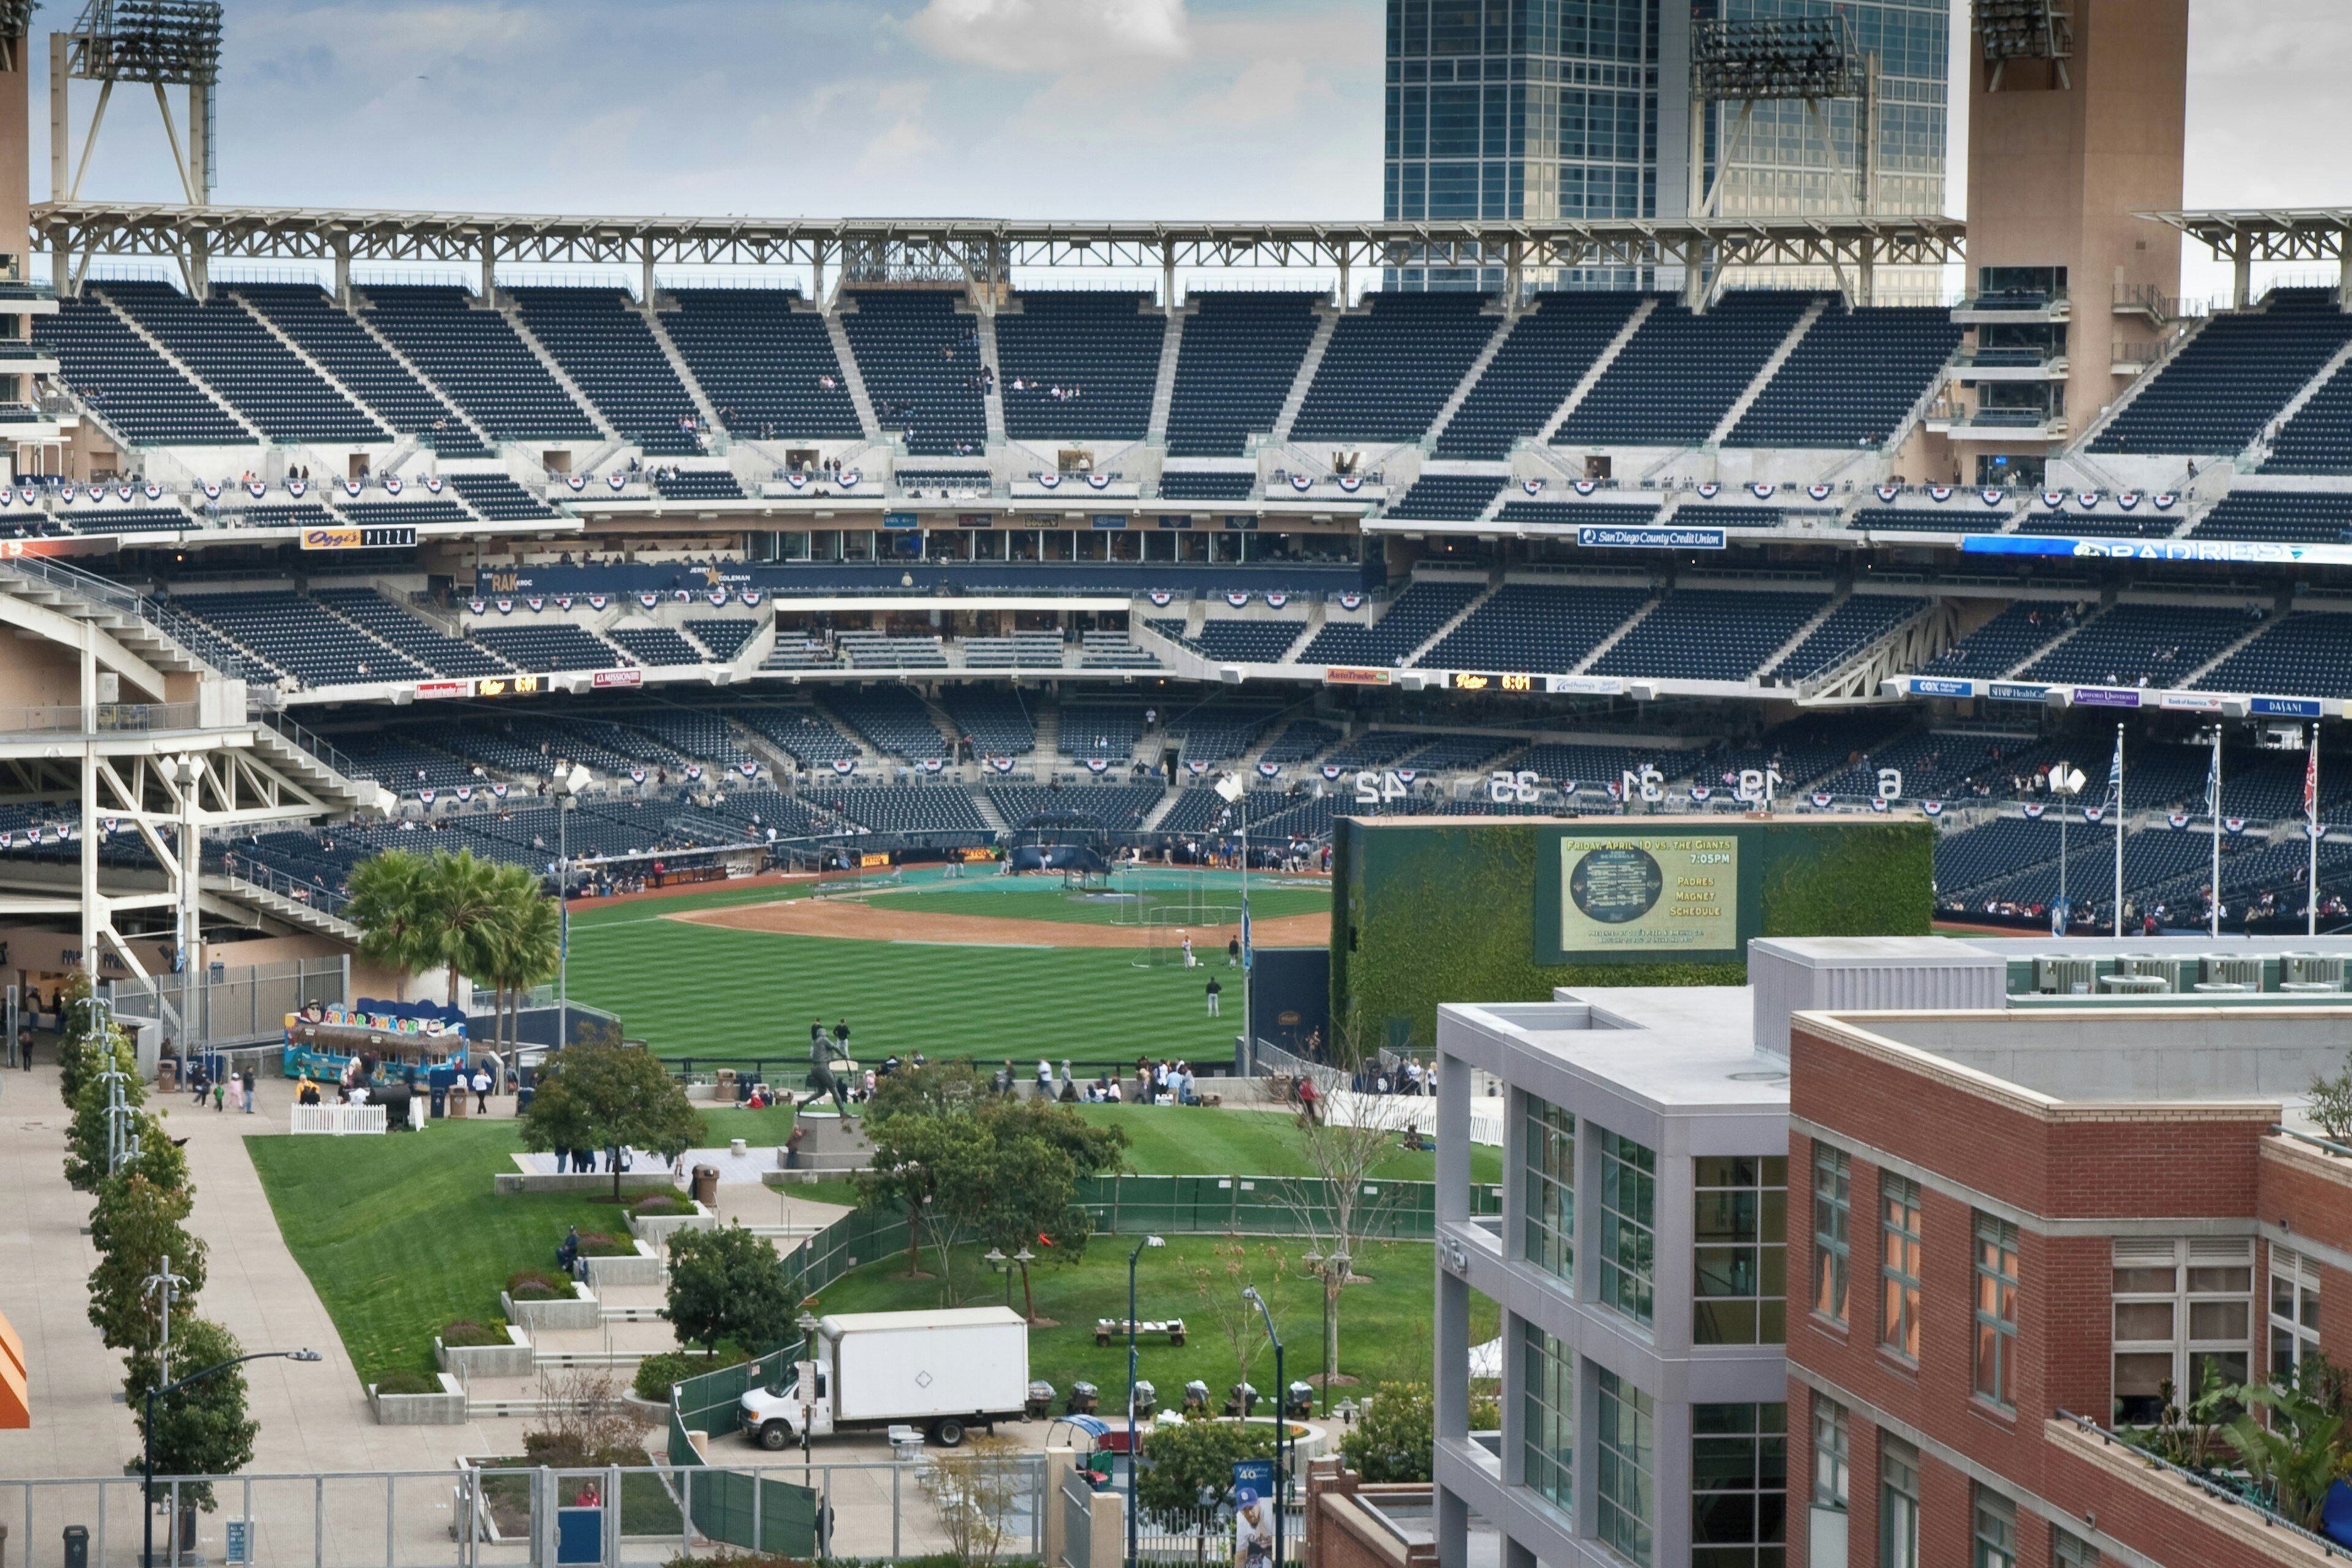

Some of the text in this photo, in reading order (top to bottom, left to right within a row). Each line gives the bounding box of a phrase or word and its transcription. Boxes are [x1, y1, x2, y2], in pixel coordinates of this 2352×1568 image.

[308, 530, 412, 546] Oggi's PIZZA
[1599, 531, 1719, 545] San Diego County Credit Union
[492, 573, 518, 592] RAK
[605, 673, 630, 682] MISSION
[1329, 670, 1376, 680] AutoTrader
[1502, 674, 1531, 690] 6:01
[1920, 682, 1939, 692] COX
[1992, 687, 2013, 696] SHARP
[2076, 690, 2137, 701] ASHFORD UNIVERSITY
[2269, 701, 2302, 713] DASANI
[1567, 841, 1602, 851] FRIDAY,
[1605, 840, 1634, 850] APRIL
[1638, 841, 1651, 850] 10
[1695, 840, 1731, 850] GIANTS
[1690, 854, 1730, 864] 7:05PM
[1678, 876, 1715, 887] PADRES
[1675, 891, 1716, 902] MAGNET
[1669, 906, 1721, 916] SCHEDULE
[324, 1011, 367, 1027] FRIAR
[369, 1016, 419, 1033] SHACK
[1240, 1470, 1257, 1479] 40
